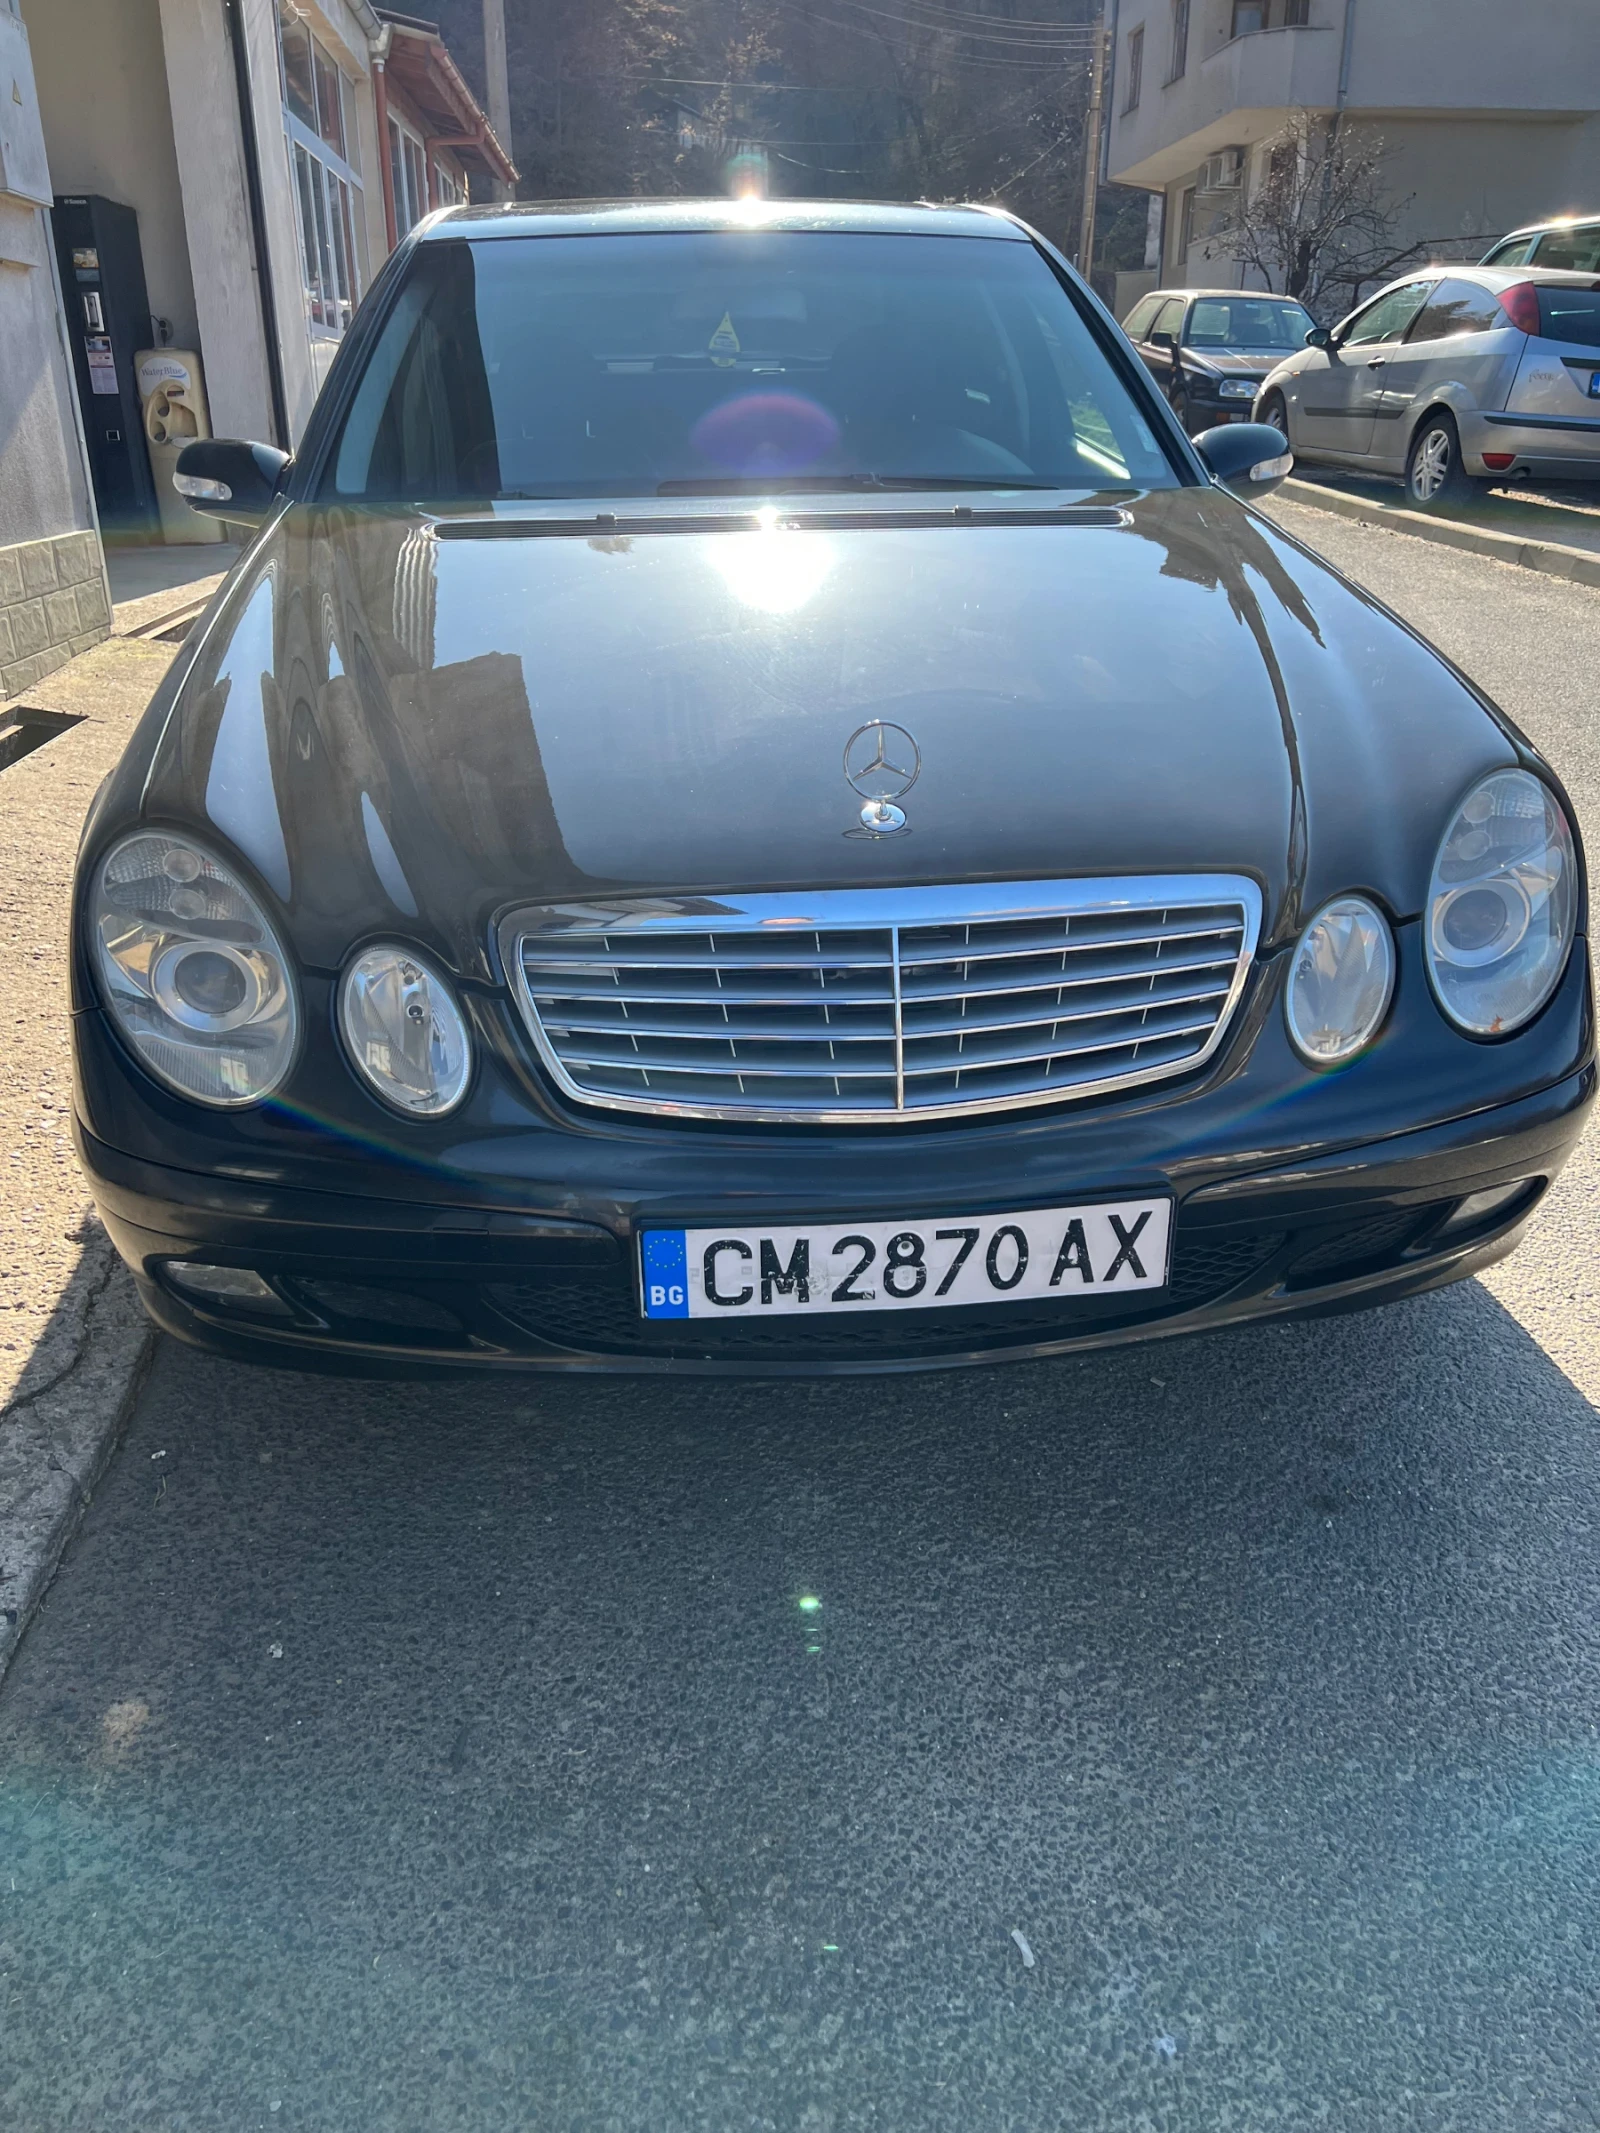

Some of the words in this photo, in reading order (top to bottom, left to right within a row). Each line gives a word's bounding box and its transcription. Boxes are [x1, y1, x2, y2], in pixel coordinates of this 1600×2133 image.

[703, 1238, 811, 1306] CM
[831, 1224, 1029, 1302] 2870
[1048, 1211, 1153, 1287] AX
[651, 1285, 684, 1306] BG
